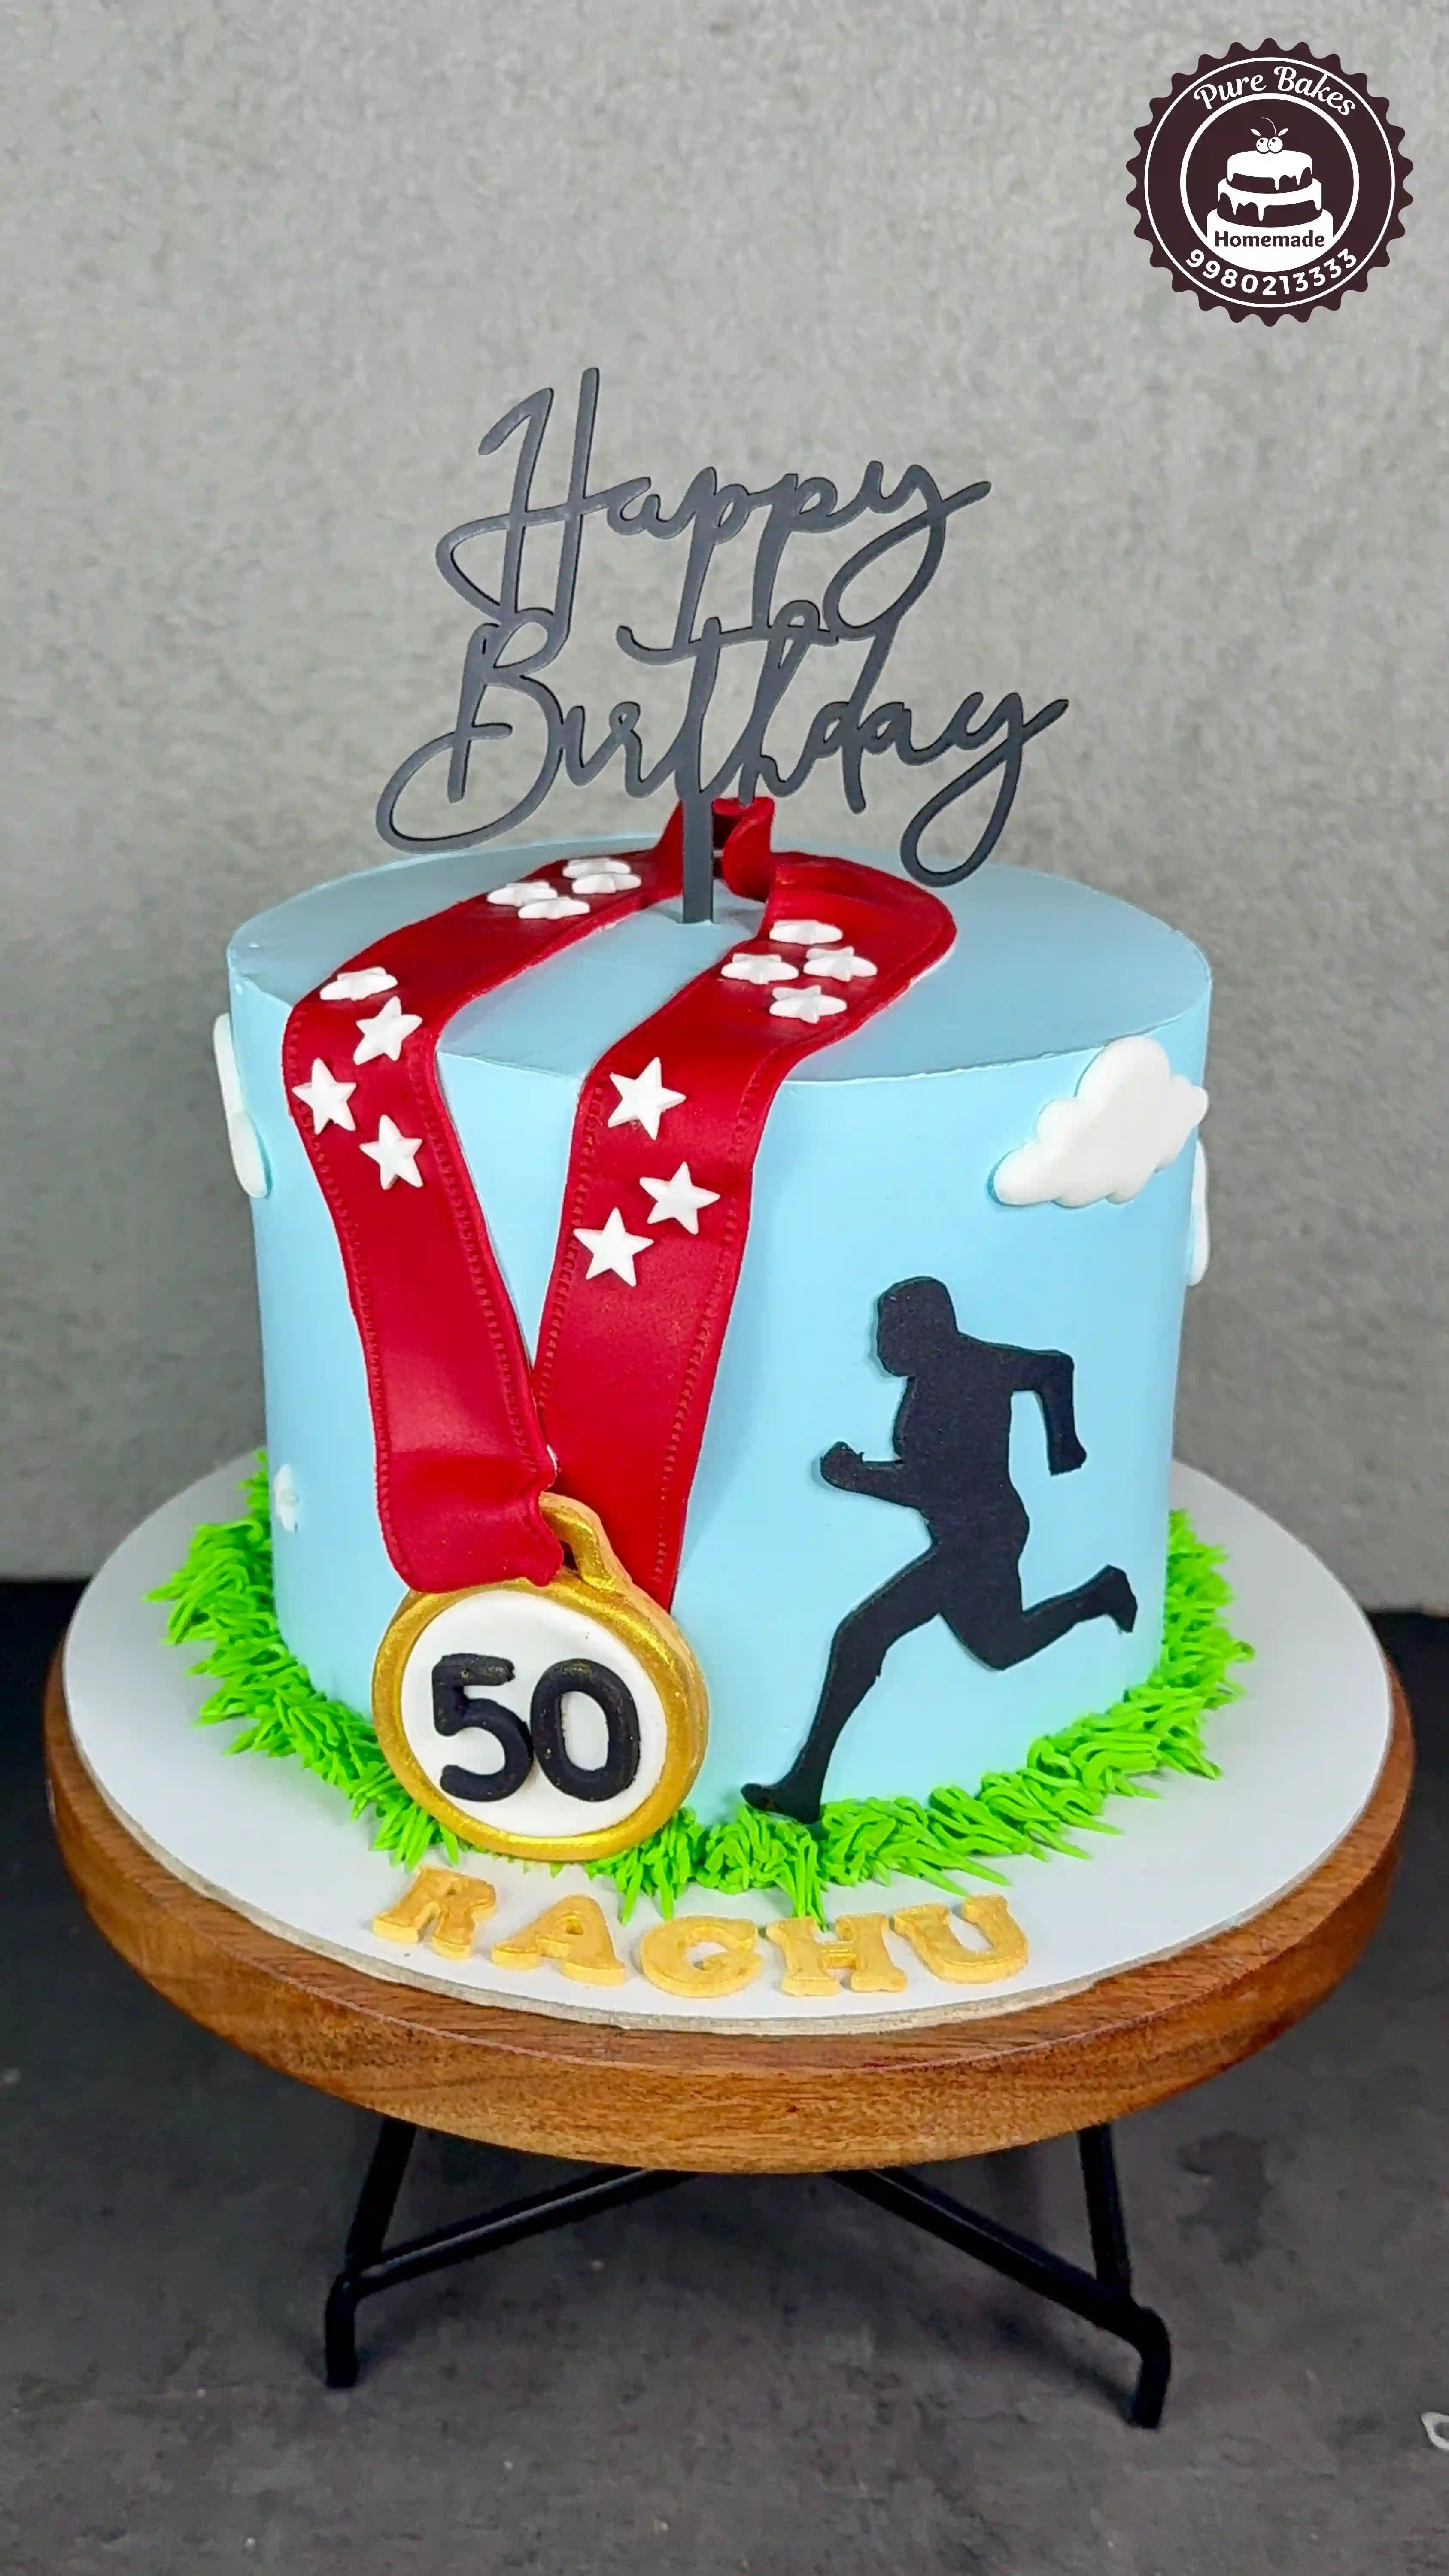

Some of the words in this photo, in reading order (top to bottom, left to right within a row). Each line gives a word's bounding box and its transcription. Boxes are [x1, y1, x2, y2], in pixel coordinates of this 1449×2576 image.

[435, 367, 992, 648] Happy
[376, 599, 1069, 887] Birthday
[431, 1652, 641, 1803] 50
[372, 1867, 1028, 1999] RAGHU
